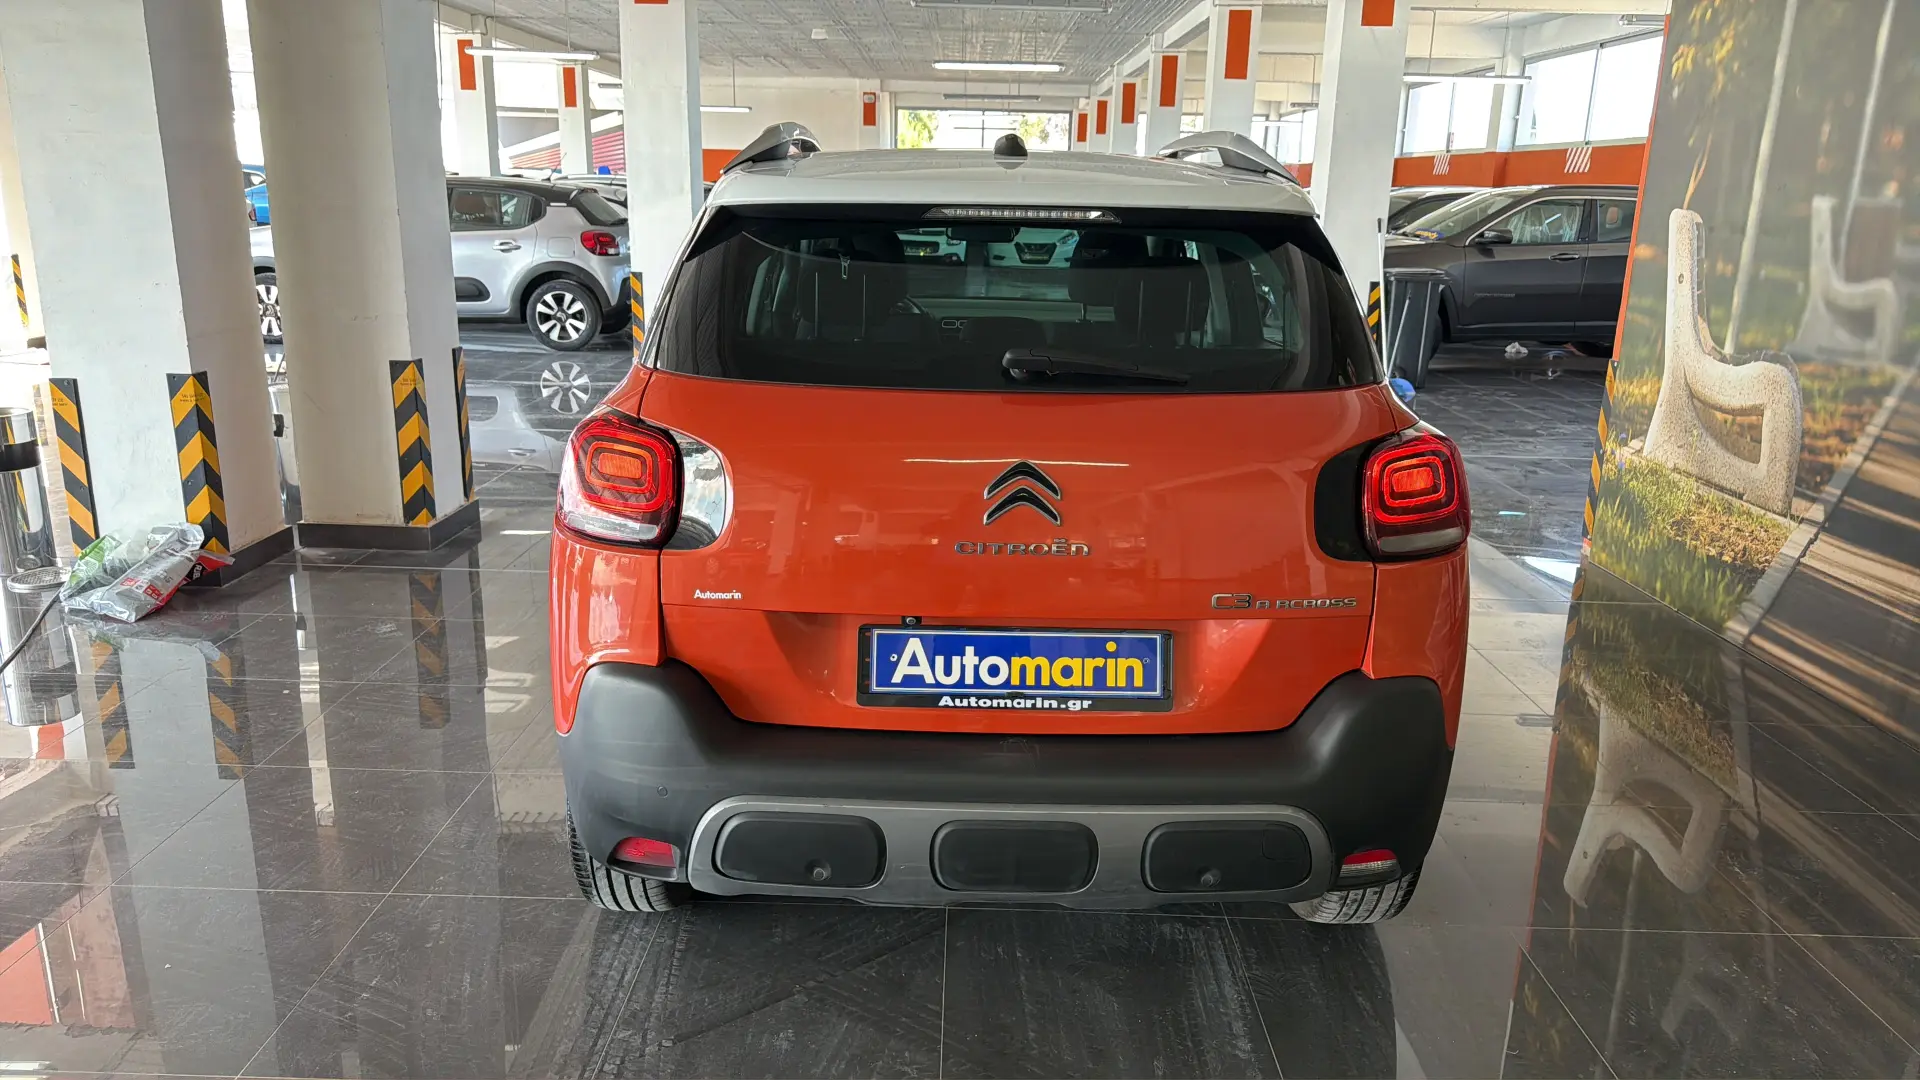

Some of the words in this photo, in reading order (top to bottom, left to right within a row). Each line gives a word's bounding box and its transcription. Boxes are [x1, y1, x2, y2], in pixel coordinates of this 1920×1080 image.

[954, 538, 1090, 556] CITROËN
[693, 588, 743, 600] Automarin
[1211, 592, 1252, 610] C3
[890, 637, 1145, 688] Automarin
[937, 695, 1093, 712] Automarin.gr
